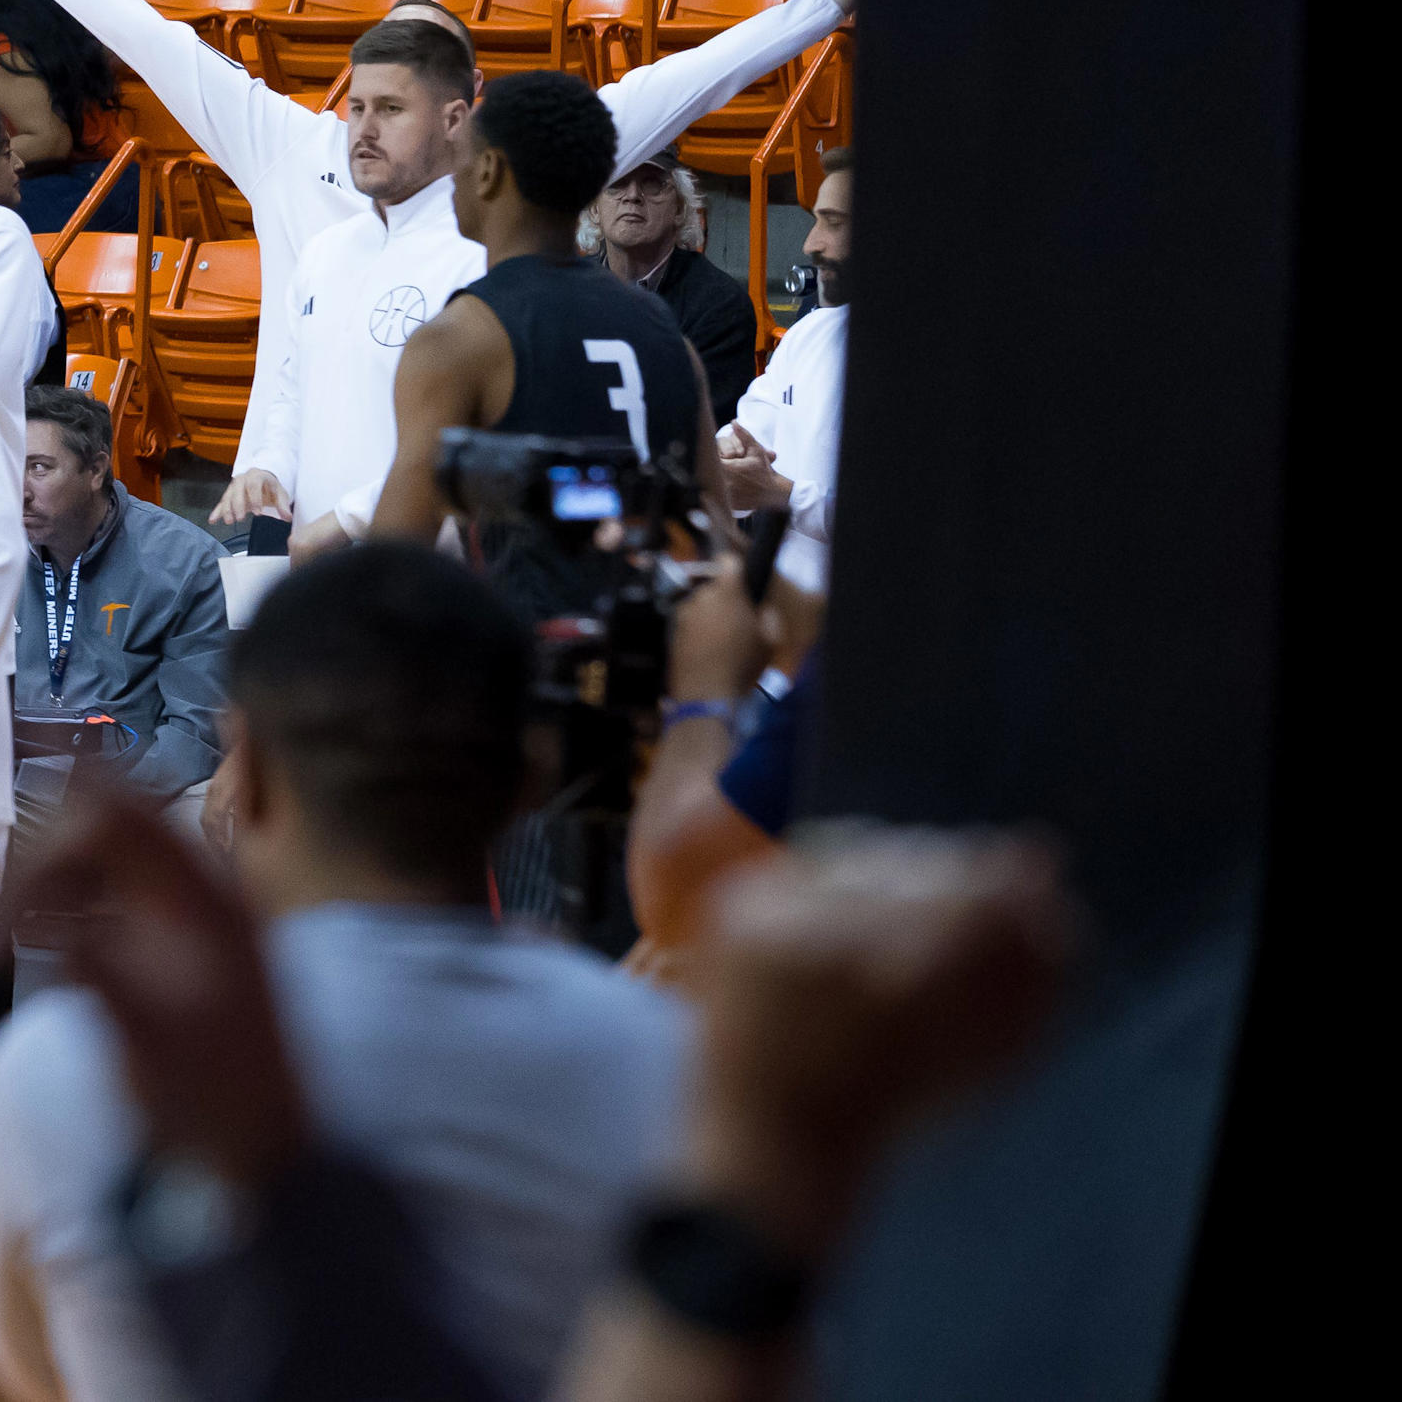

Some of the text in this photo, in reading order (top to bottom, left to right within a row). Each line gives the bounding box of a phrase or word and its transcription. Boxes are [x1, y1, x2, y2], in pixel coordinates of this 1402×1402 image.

[815, 140, 823, 156] 4
[76, 373, 90, 389] 14
[44, 562, 59, 659] UTEP MINERS
[61, 605, 77, 642] UTEP
